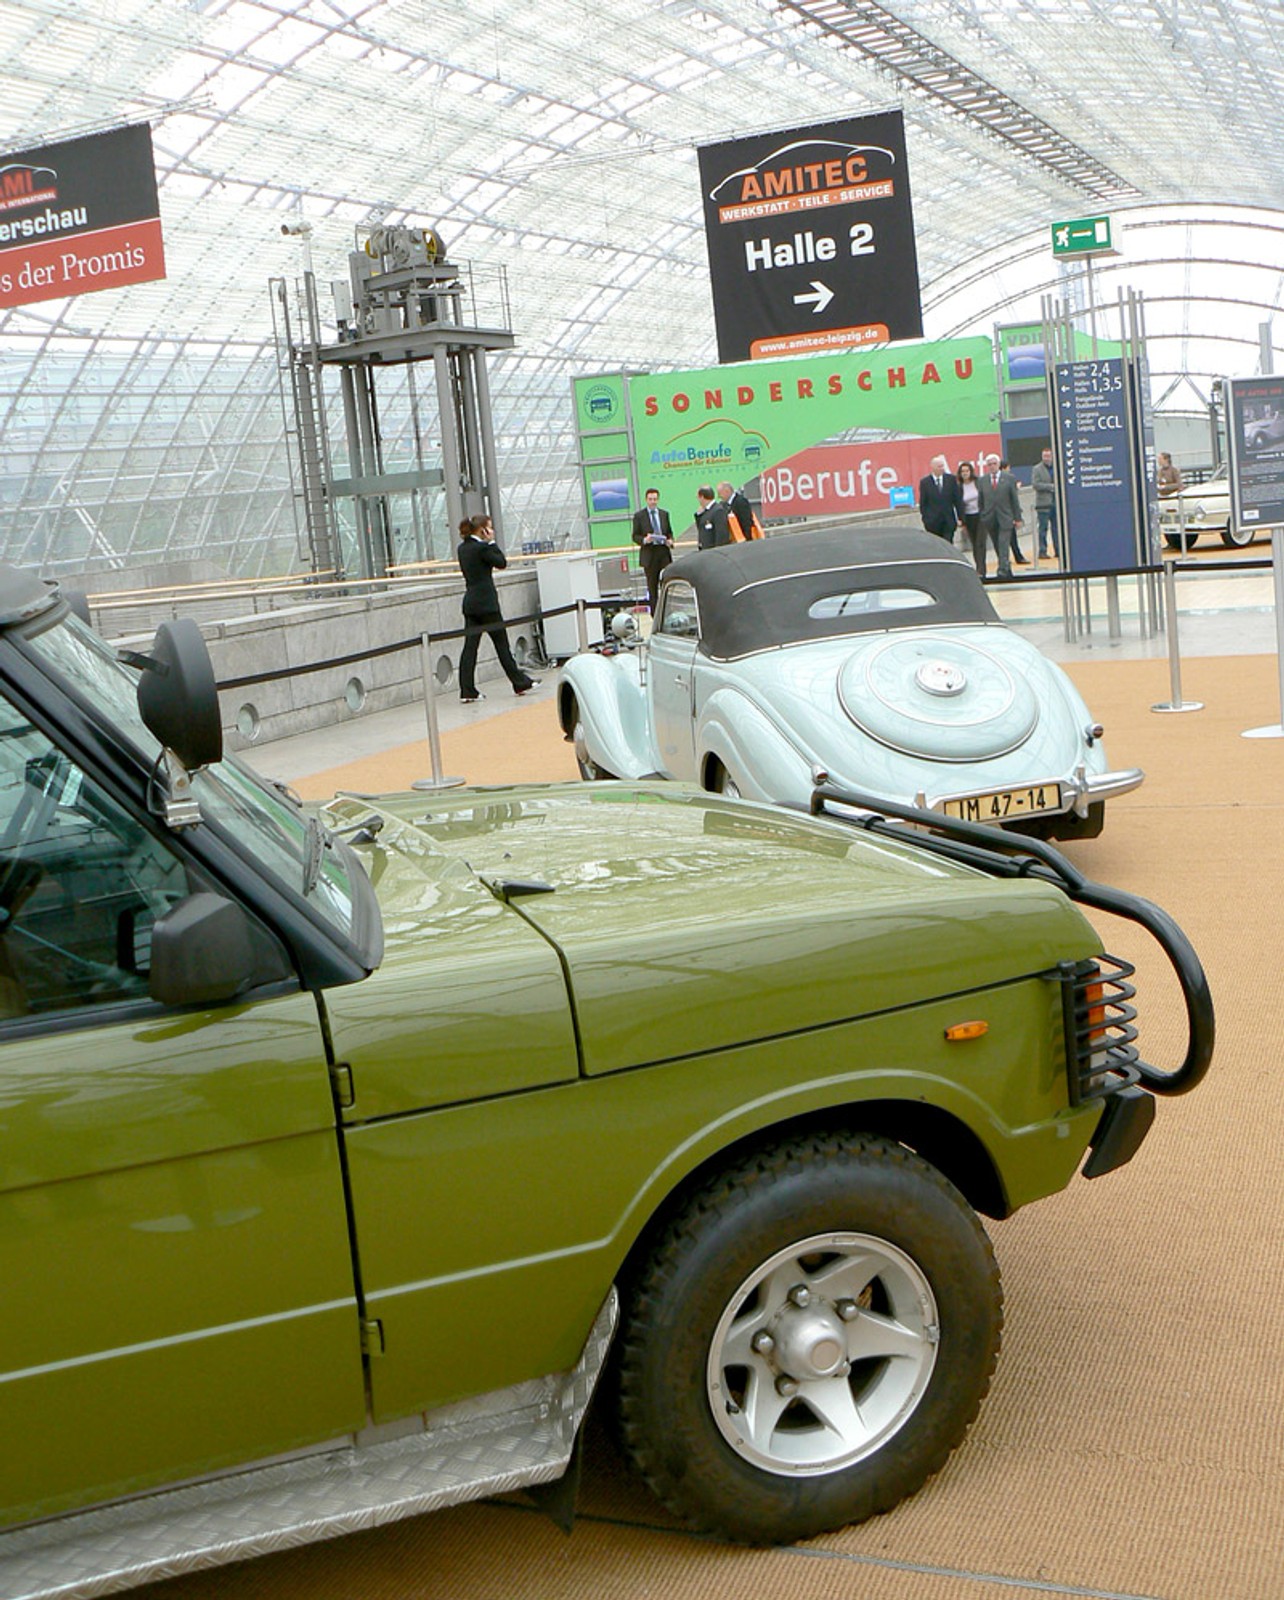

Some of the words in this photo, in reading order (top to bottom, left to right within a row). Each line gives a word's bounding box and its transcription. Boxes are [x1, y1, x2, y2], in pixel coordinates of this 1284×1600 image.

[0, 168, 33, 199] MI
[741, 155, 868, 202] AMITEC
[722, 200, 790, 220] WERKSTATT
[798, 193, 830, 208] TEILE
[840, 184, 891, 201] SERVICE
[745, 231, 836, 272] Halle
[849, 222, 875, 257] 2
[18, 261, 56, 289] der
[61, 242, 146, 281] Promis
[759, 328, 878, 353] www.amitec-leipzig.de
[645, 357, 973, 416] SONDERSCHAU
[1092, 376, 1123, 393] 1,3,5
[1097, 415, 1123, 430] CCL
[650, 443, 732, 464] AutoBerufe
[991, 788, 1046, 816] 47-14
